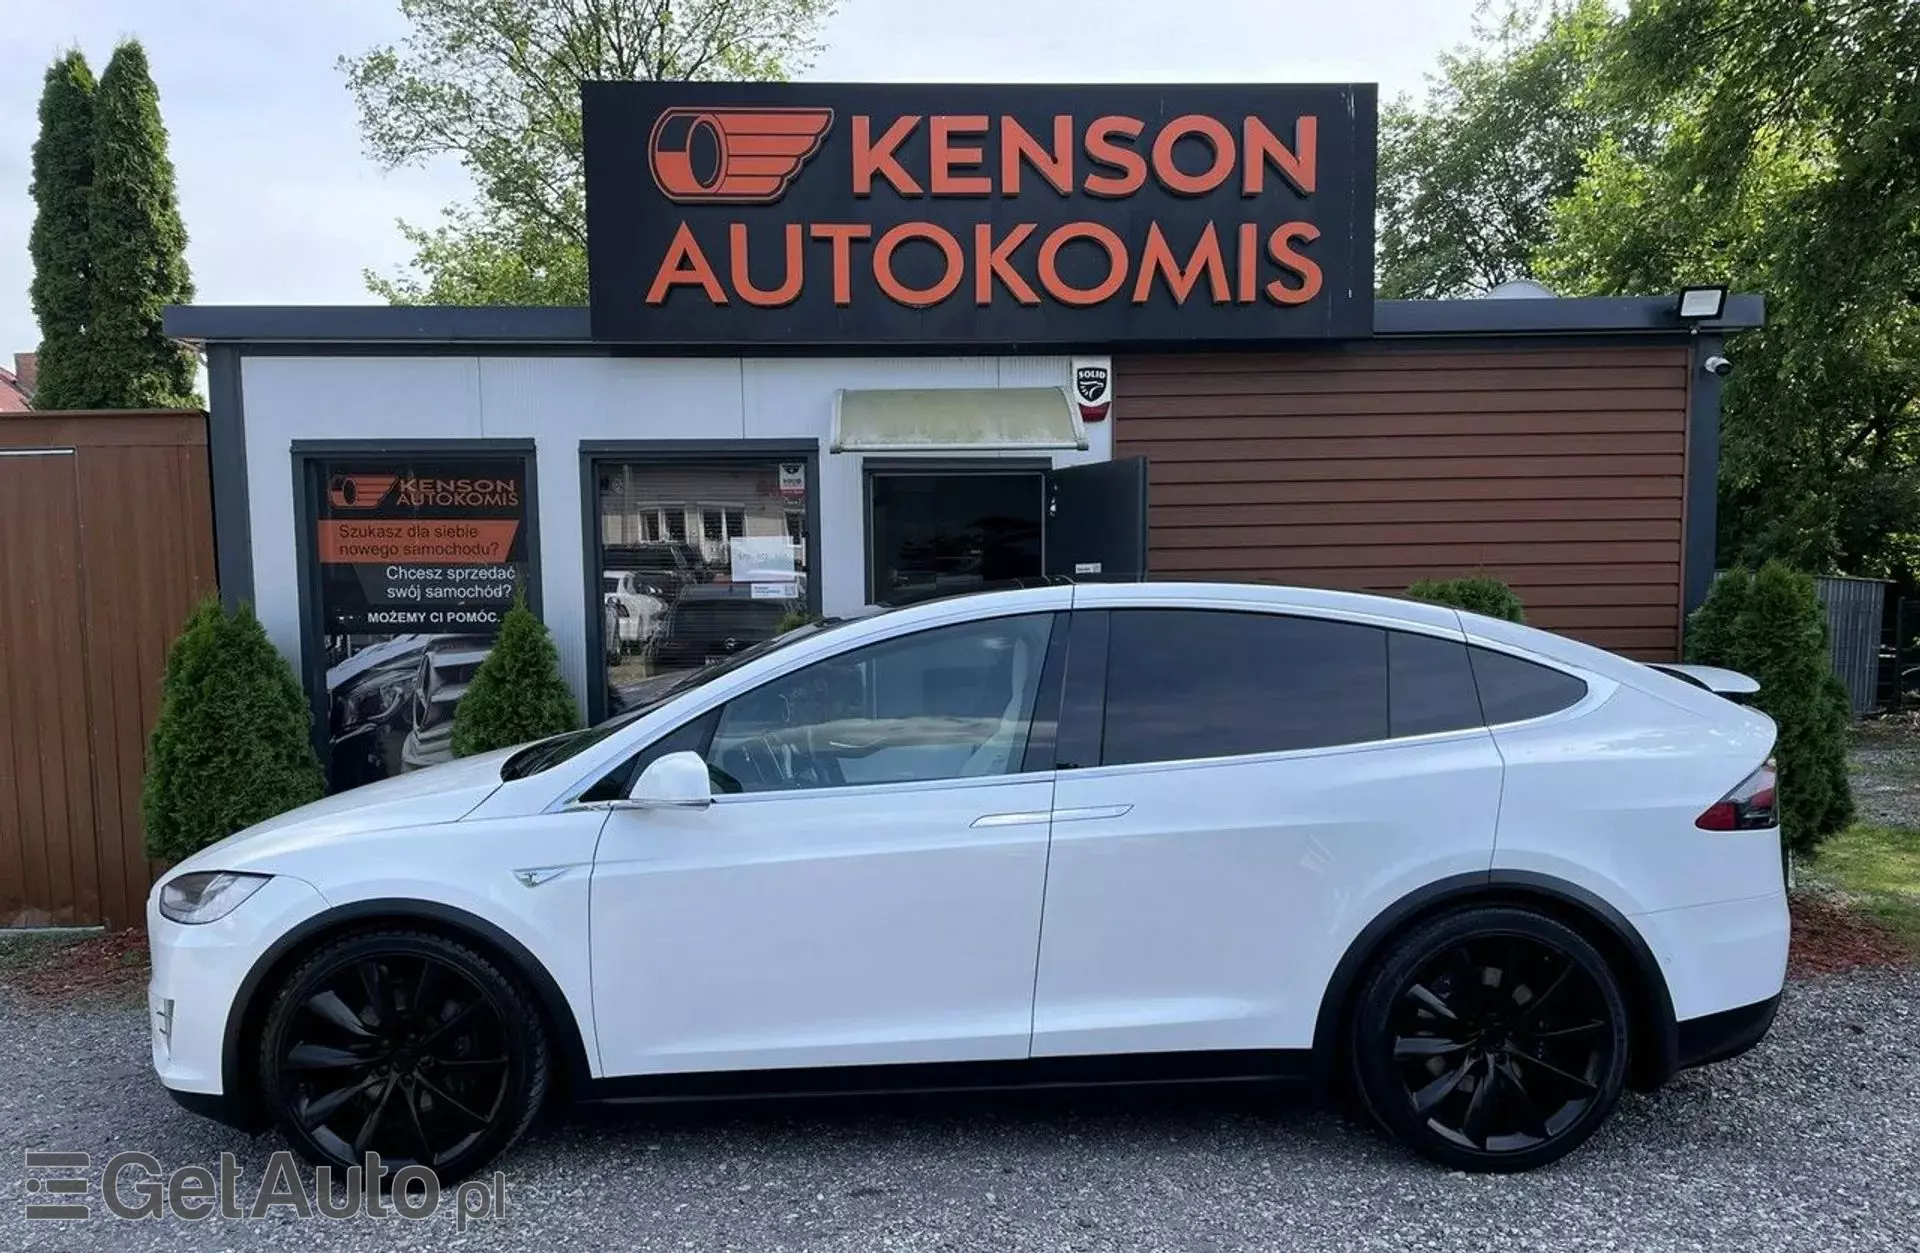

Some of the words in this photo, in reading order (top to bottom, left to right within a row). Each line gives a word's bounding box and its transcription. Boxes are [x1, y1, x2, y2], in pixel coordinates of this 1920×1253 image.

[851, 114, 1318, 198] KENSON
[644, 220, 1324, 307] AUTOKOMIS
[1078, 370, 1106, 379] SOLID
[400, 479, 516, 493] KENSON
[396, 493, 519, 507] AUTOKOMIS
[339, 524, 402, 538] Szukasz
[407, 524, 430, 538] dla
[434, 524, 478, 538] siebie
[339, 544, 399, 559] nowego
[403, 541, 499, 556] samochodu?
[386, 565, 443, 580] Chcesz
[446, 565, 516, 581] sprzedać
[386, 584, 421, 601] swój
[425, 584, 512, 599] samochód?
[367, 610, 426, 623] MOŻEMY
[429, 612, 444, 623] CI
[447, 610, 501, 623] POMÓC.
